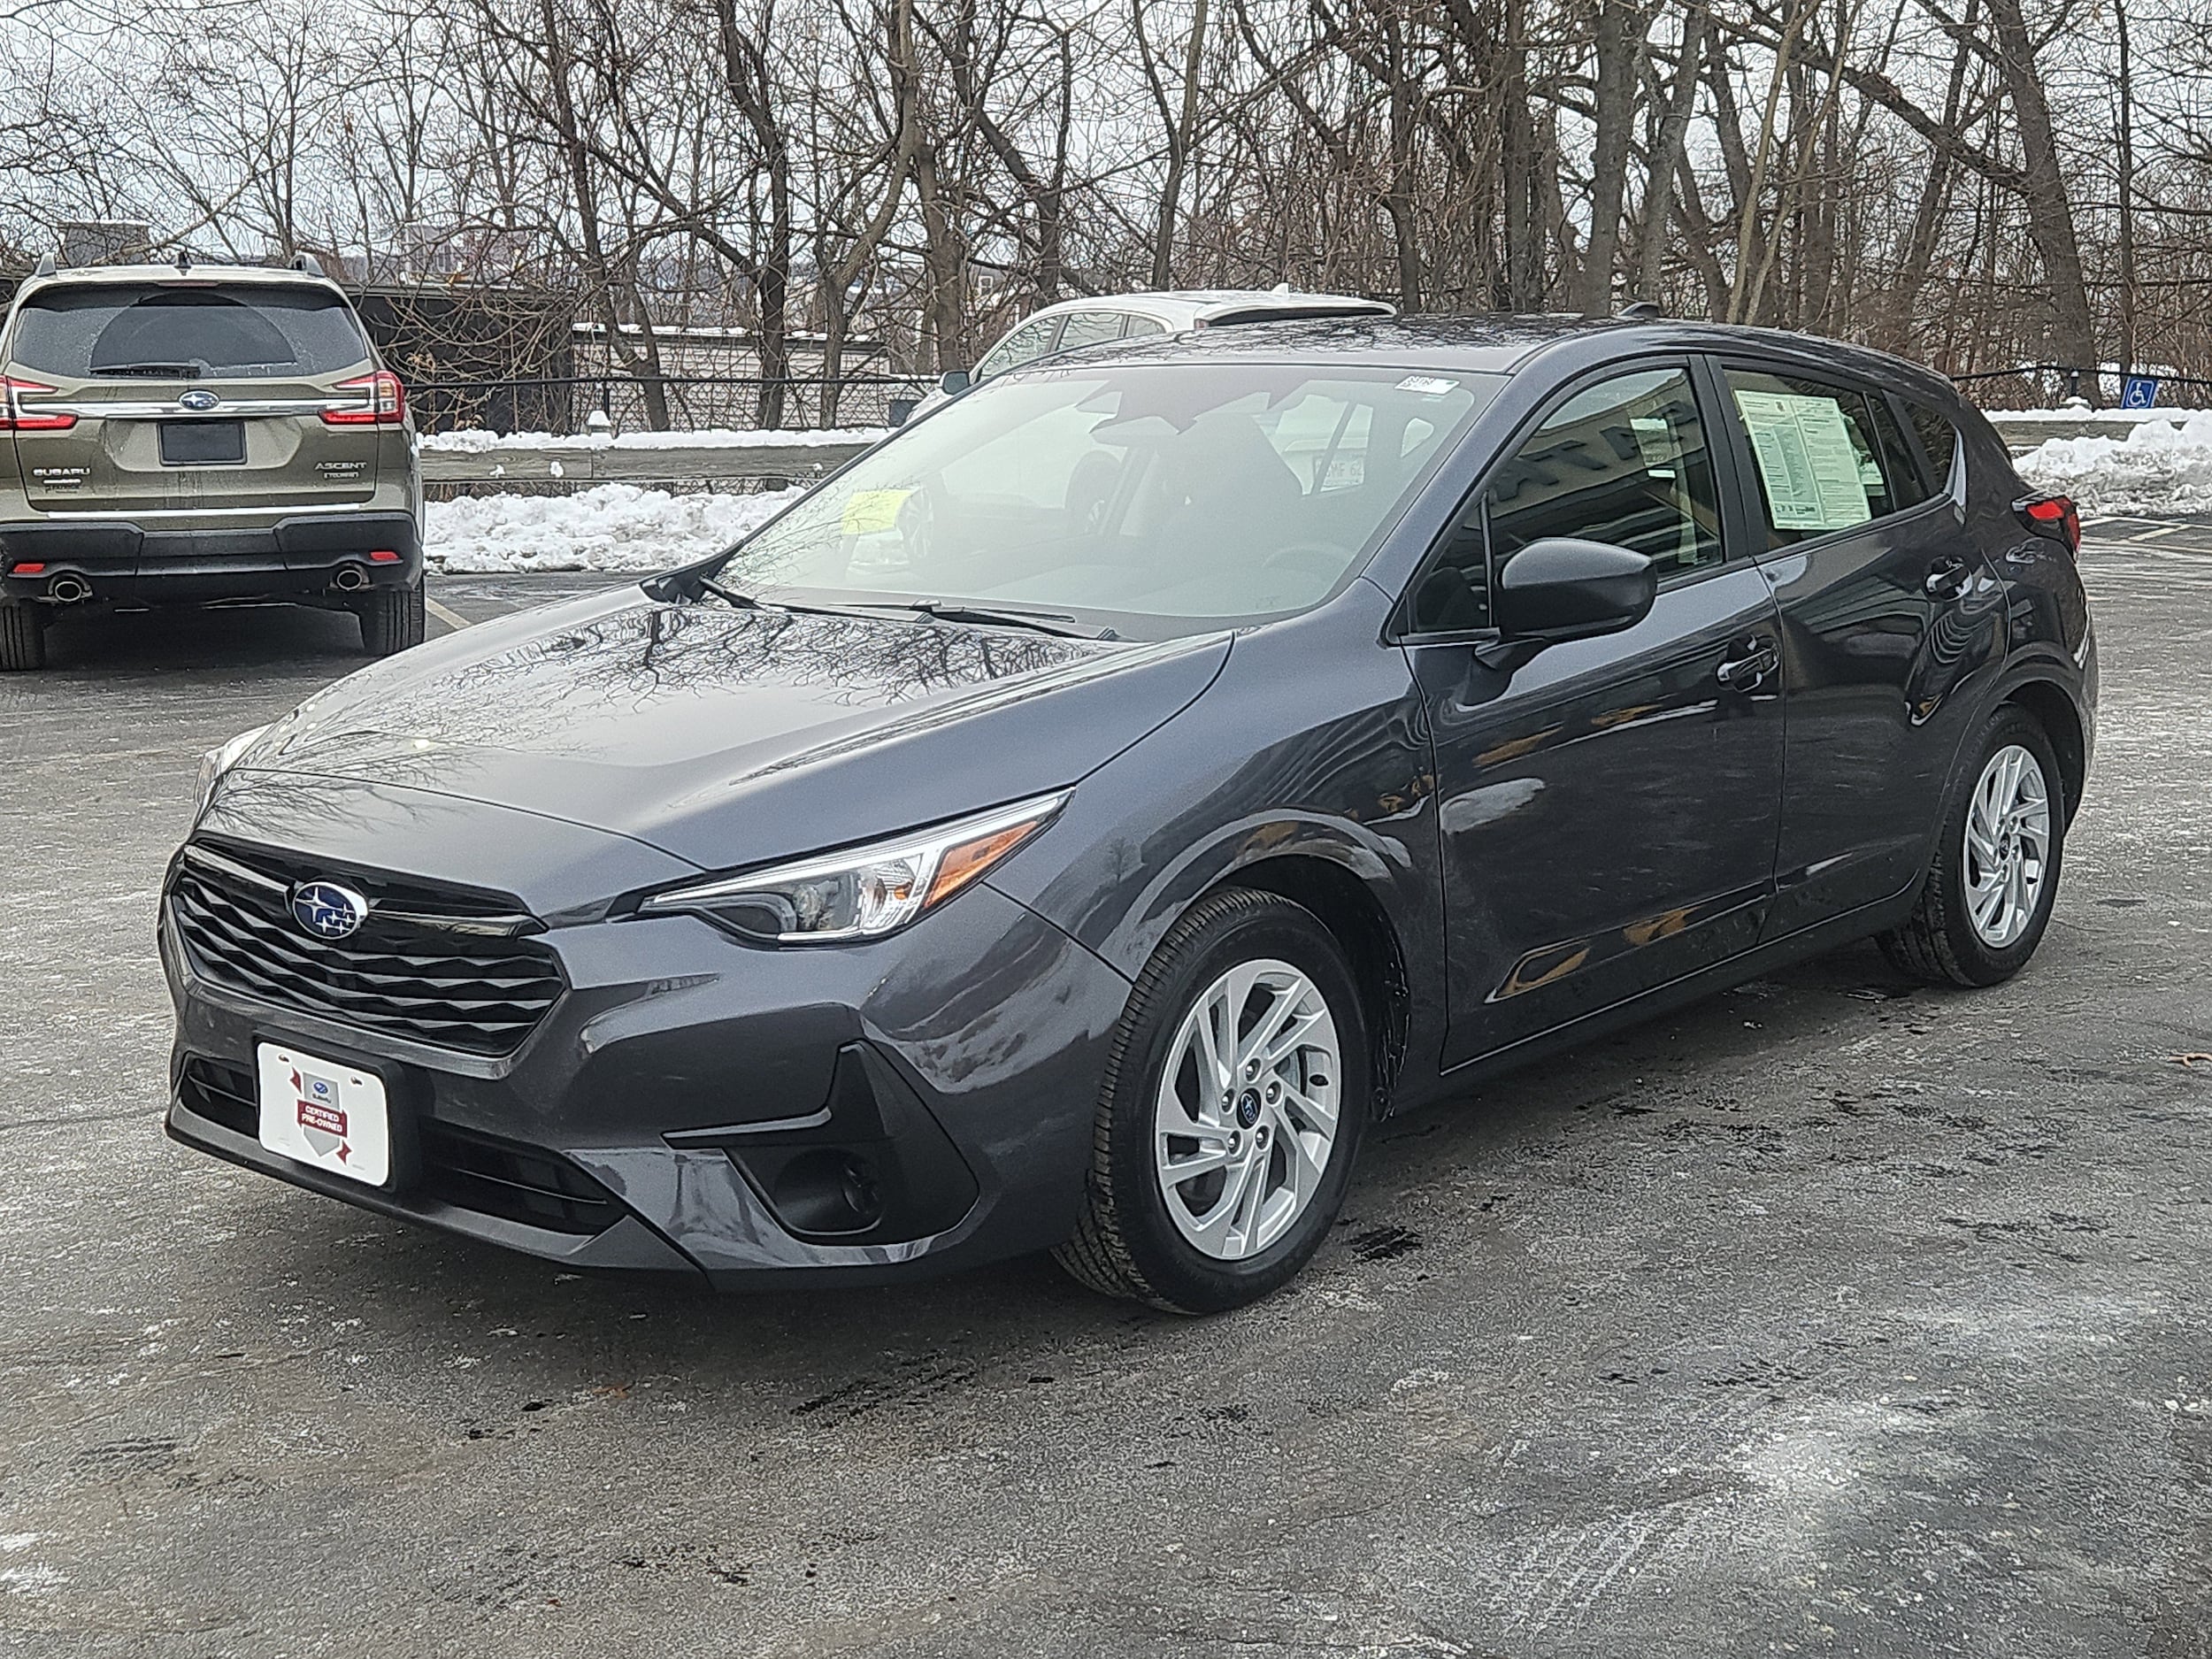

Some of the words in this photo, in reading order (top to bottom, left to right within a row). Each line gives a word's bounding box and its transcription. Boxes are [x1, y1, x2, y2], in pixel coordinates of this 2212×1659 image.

[33, 467, 91, 476] SUBARU
[314, 461, 367, 470] ASCENT
[305, 1105, 340, 1122] CERTIFIED
[302, 1113, 342, 1133] PRE-OWNED
